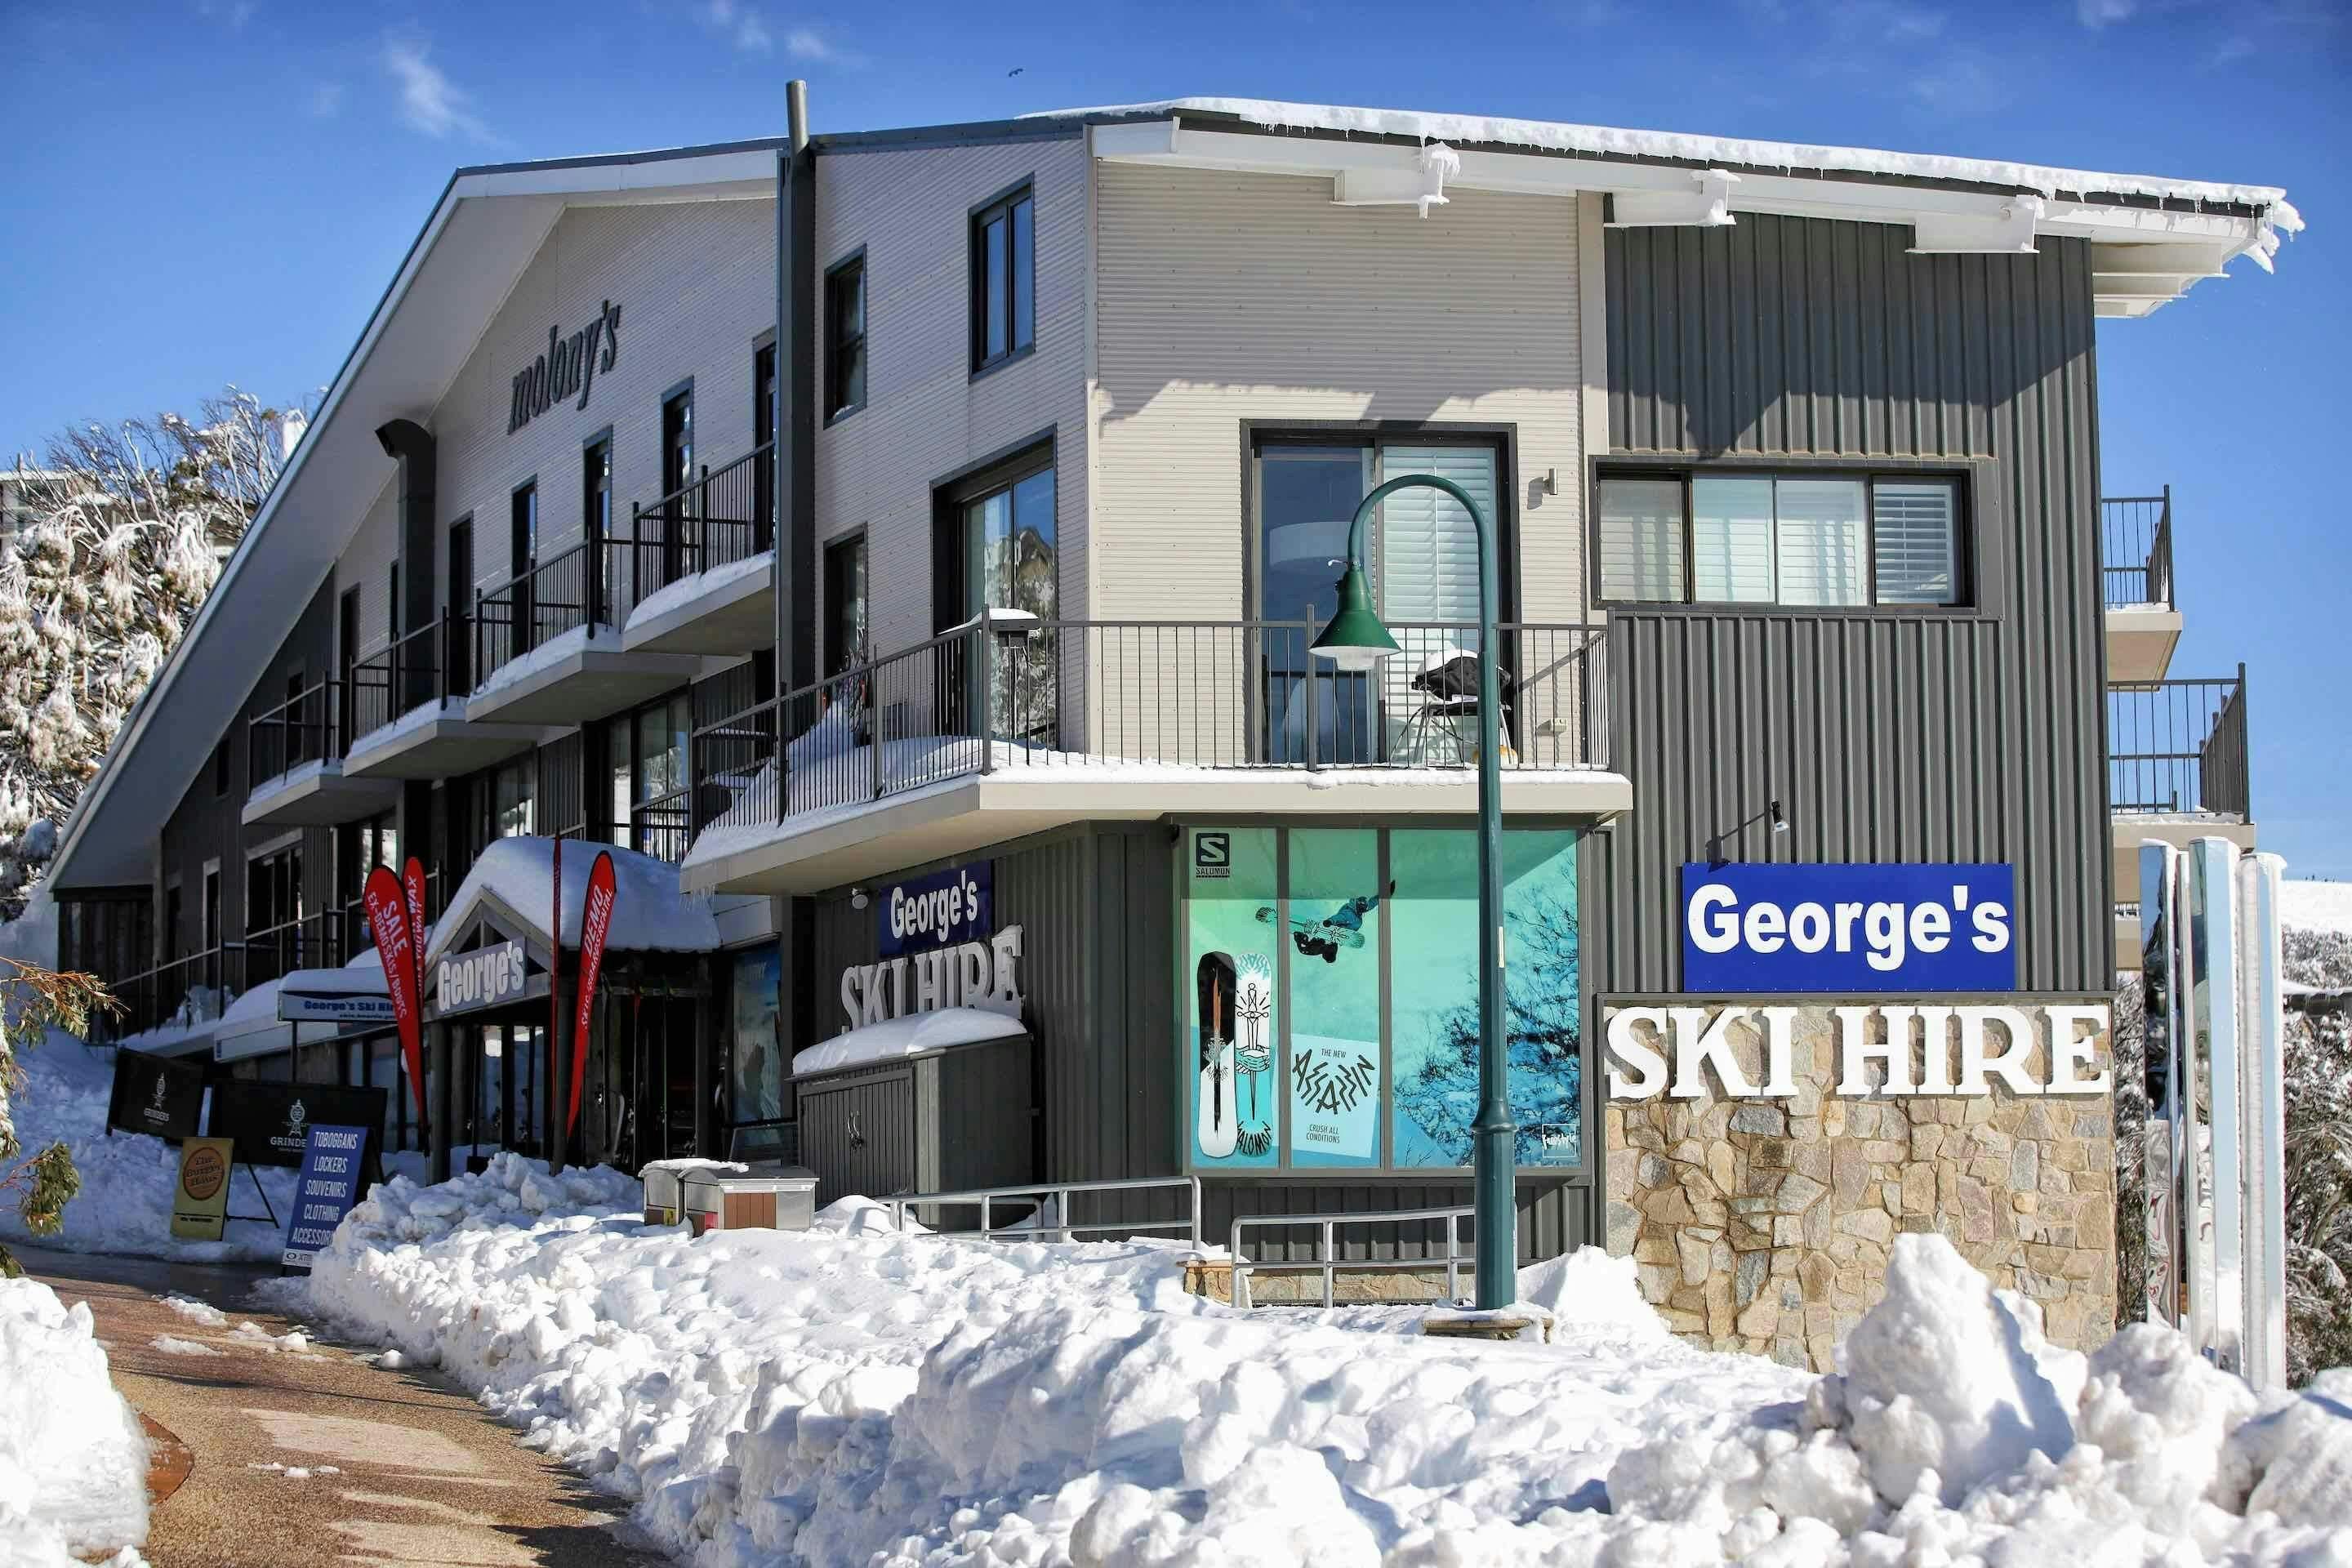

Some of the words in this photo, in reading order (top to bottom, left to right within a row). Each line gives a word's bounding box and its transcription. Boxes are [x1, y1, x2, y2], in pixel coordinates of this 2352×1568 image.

[1196, 866, 1230, 875] SALOMON
[890, 870, 978, 942] George's
[383, 900, 408, 957] SALE
[584, 884, 604, 958] DEMO
[1687, 883, 2011, 971] George's
[438, 941, 523, 1012] George's
[841, 957, 909, 1031] SKI
[915, 933, 1024, 1020] HIRE
[1321, 1048, 1332, 1058] THE
[1333, 1050, 1347, 1059] NEW
[1606, 1005, 1798, 1098] SKI
[1834, 1005, 2112, 1095] HIRE
[1292, 1049, 1376, 1115] ASSASSIN
[1306, 1132, 1340, 1143] CONDITIONS
[1309, 1124, 1328, 1134] CRUSH
[1329, 1126, 1340, 1135] ALL
[270, 1136, 307, 1148] GRINDE
[314, 1131, 358, 1150] TOBOGGANS
[313, 1155, 349, 1174] LOCKERS
[305, 1178, 348, 1198] SOUVENIRS
[303, 1203, 341, 1223] CLOTHING
